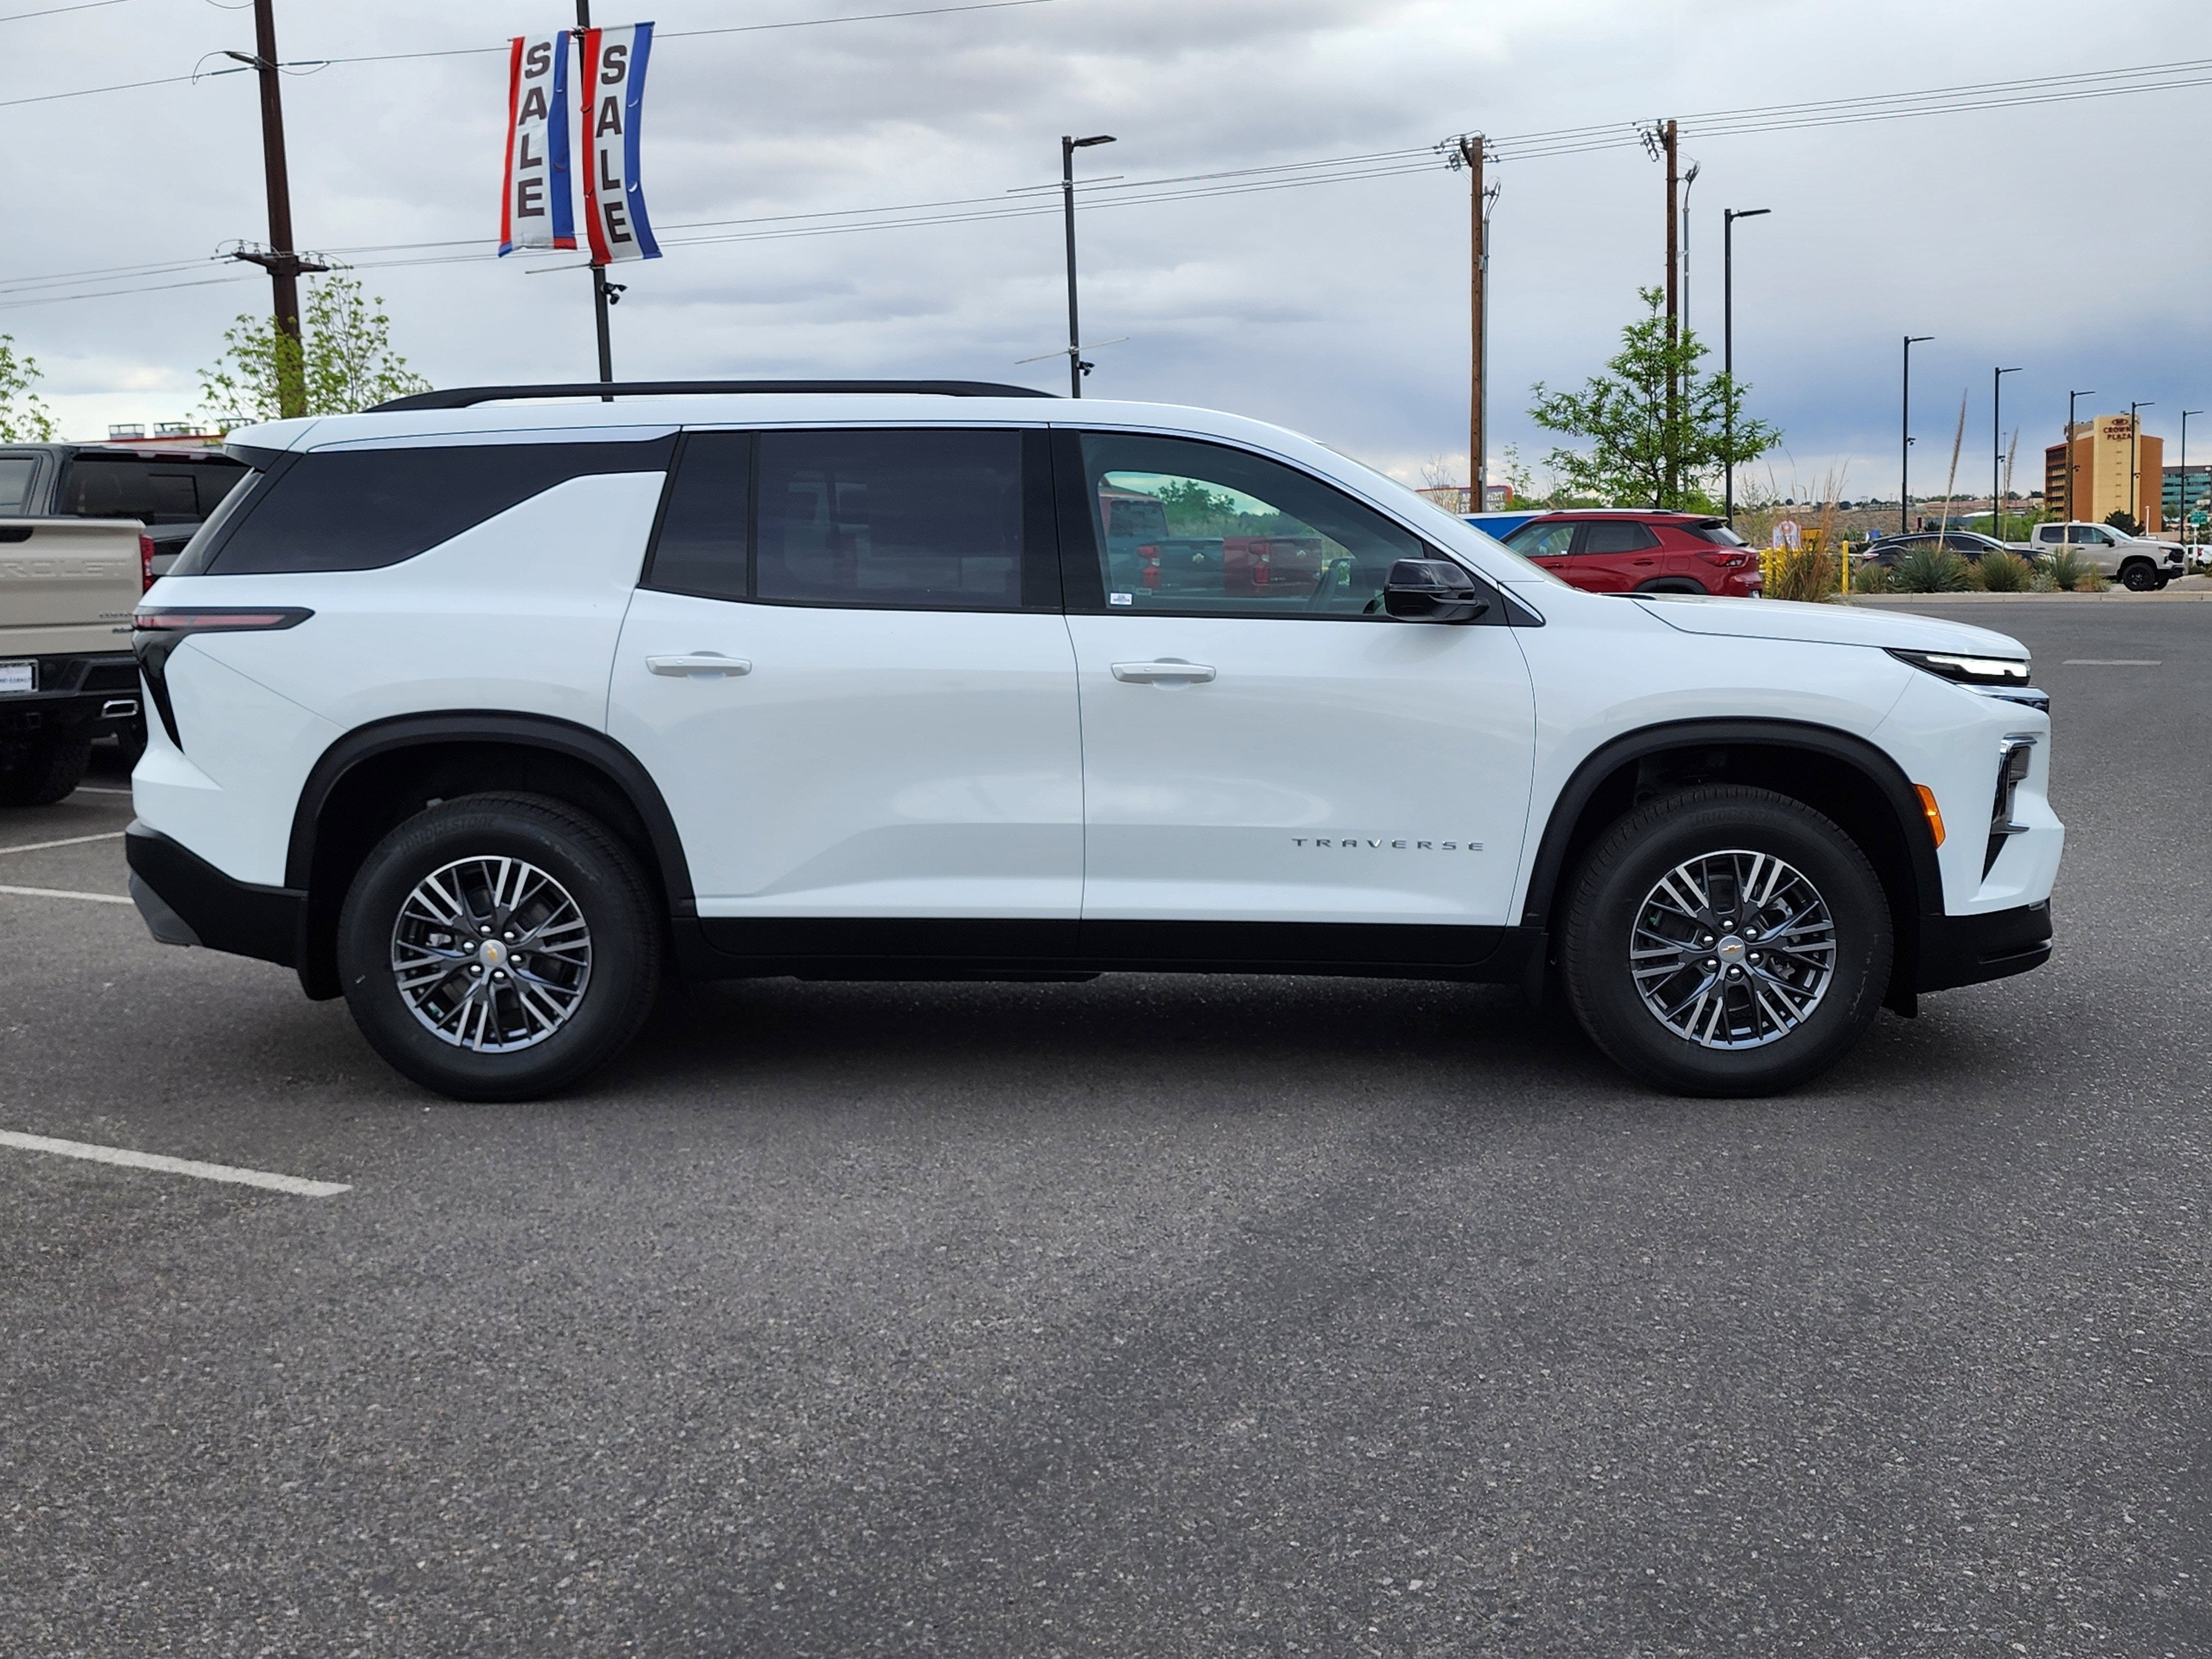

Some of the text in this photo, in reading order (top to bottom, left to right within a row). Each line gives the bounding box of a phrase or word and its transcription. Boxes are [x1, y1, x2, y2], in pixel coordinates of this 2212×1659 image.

[518, 41, 551, 218] SALE
[595, 45, 633, 243] SALE
[1291, 838, 1484, 851] TRAVERSE
